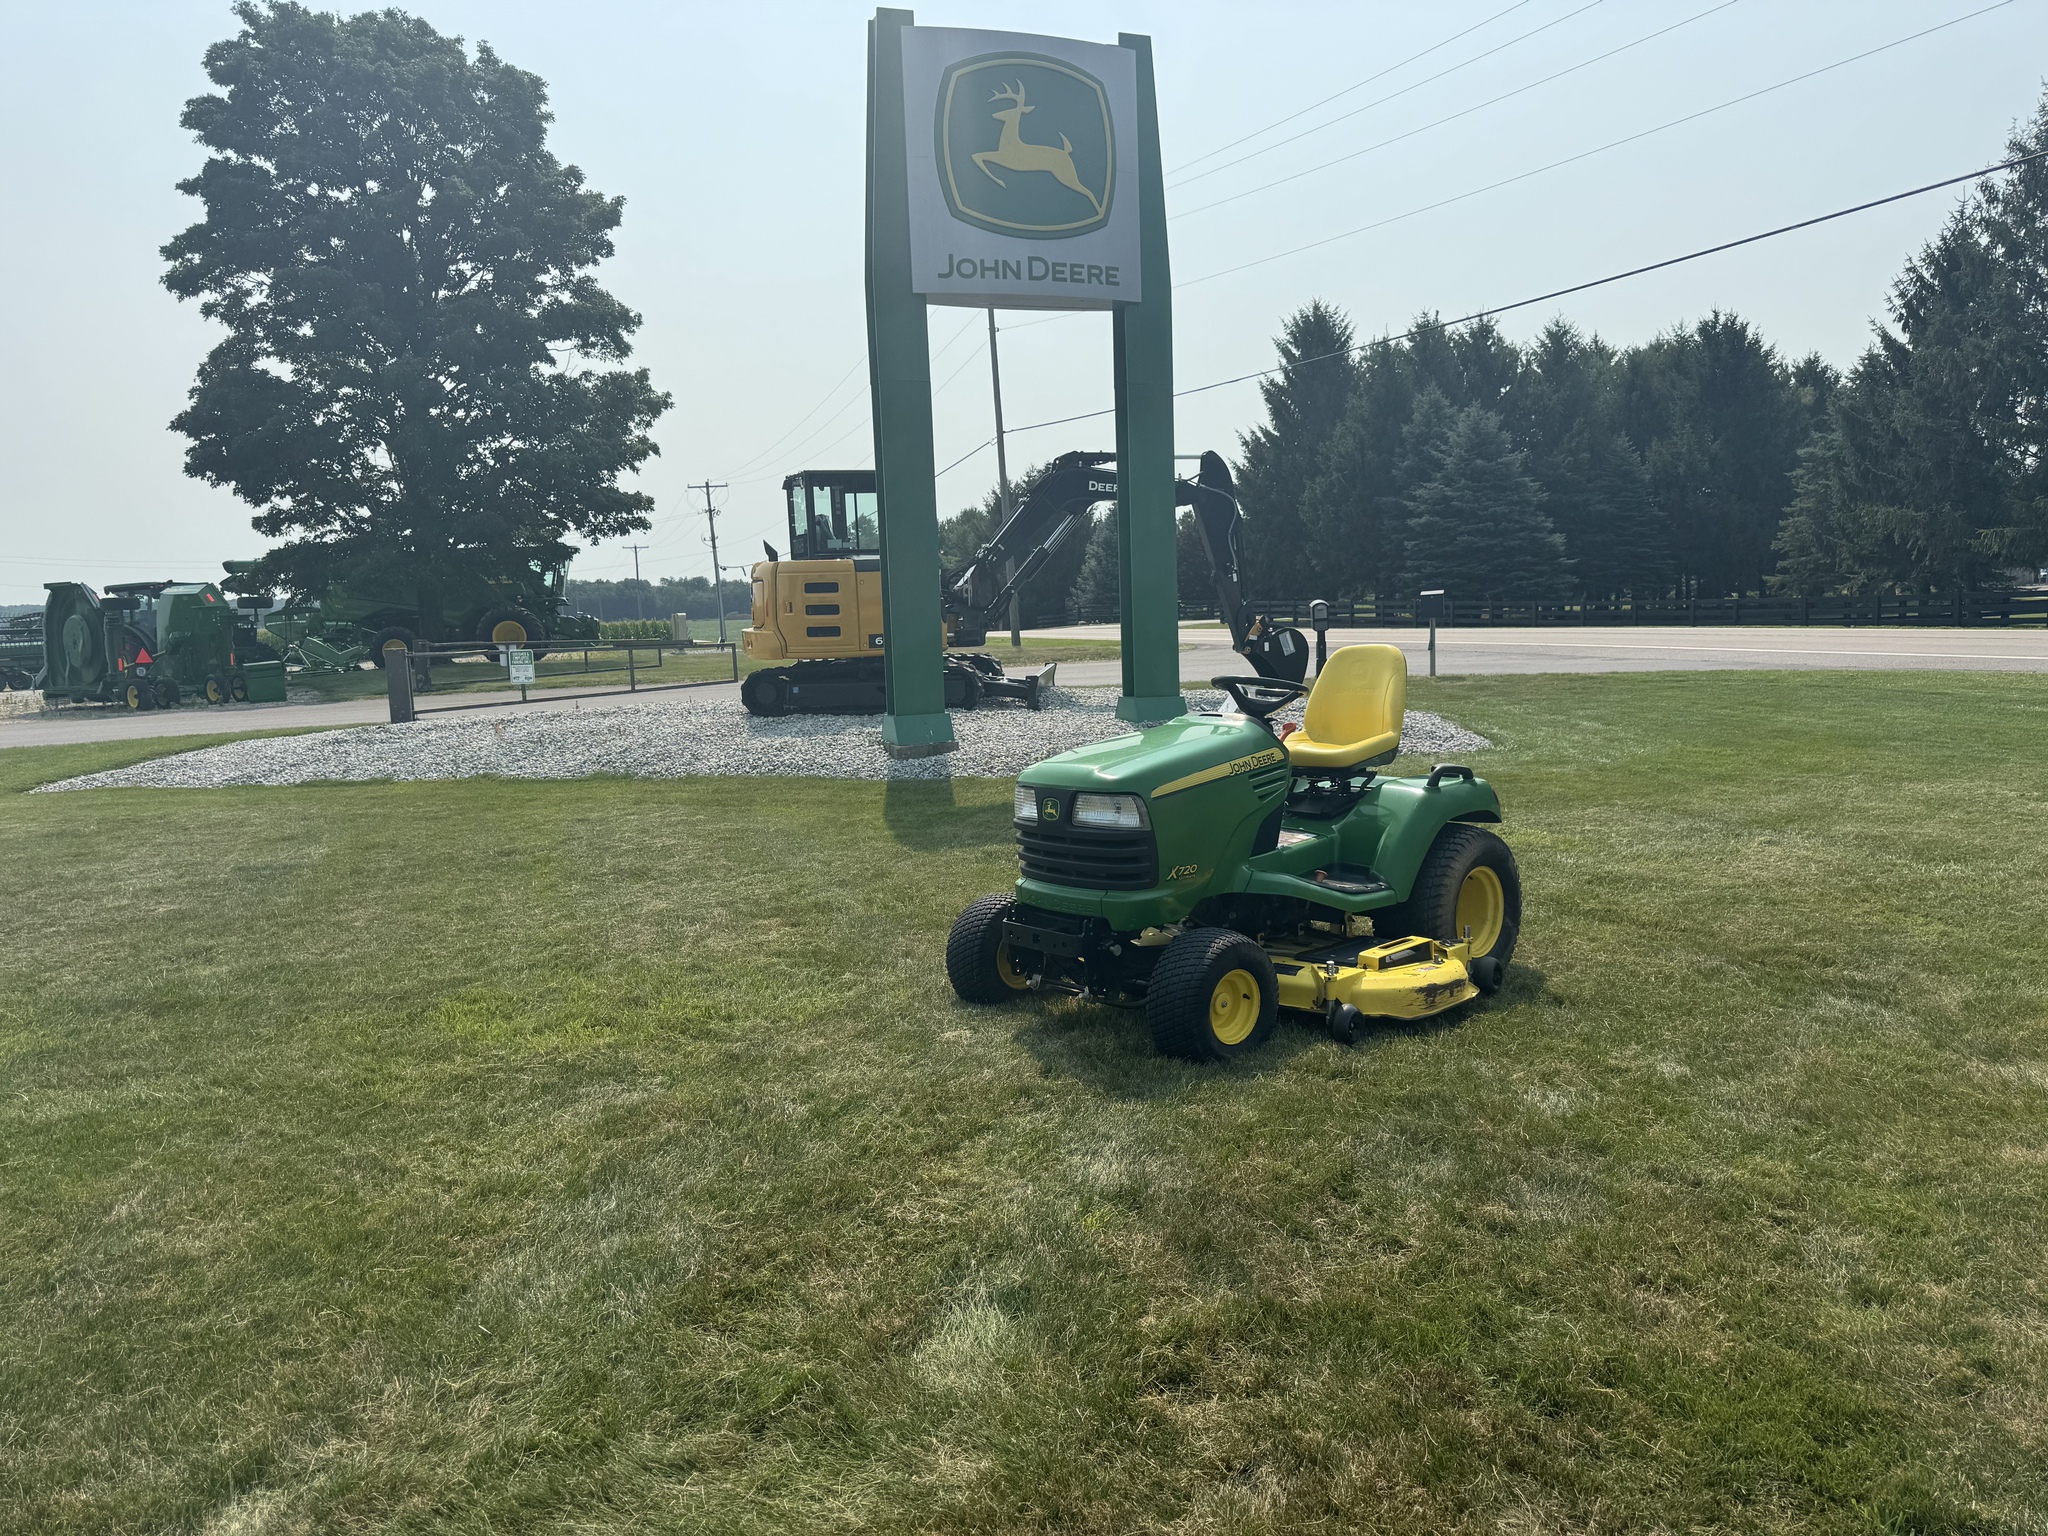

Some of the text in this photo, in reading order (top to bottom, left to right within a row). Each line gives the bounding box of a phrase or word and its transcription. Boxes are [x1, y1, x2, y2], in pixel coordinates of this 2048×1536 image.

[938, 253, 1120, 286] JOHN DEERE
[1229, 752, 1277, 774] JOHN DEERE
[1165, 863, 1198, 881] X720
[1025, 892, 1094, 914] JOHN DEERE
